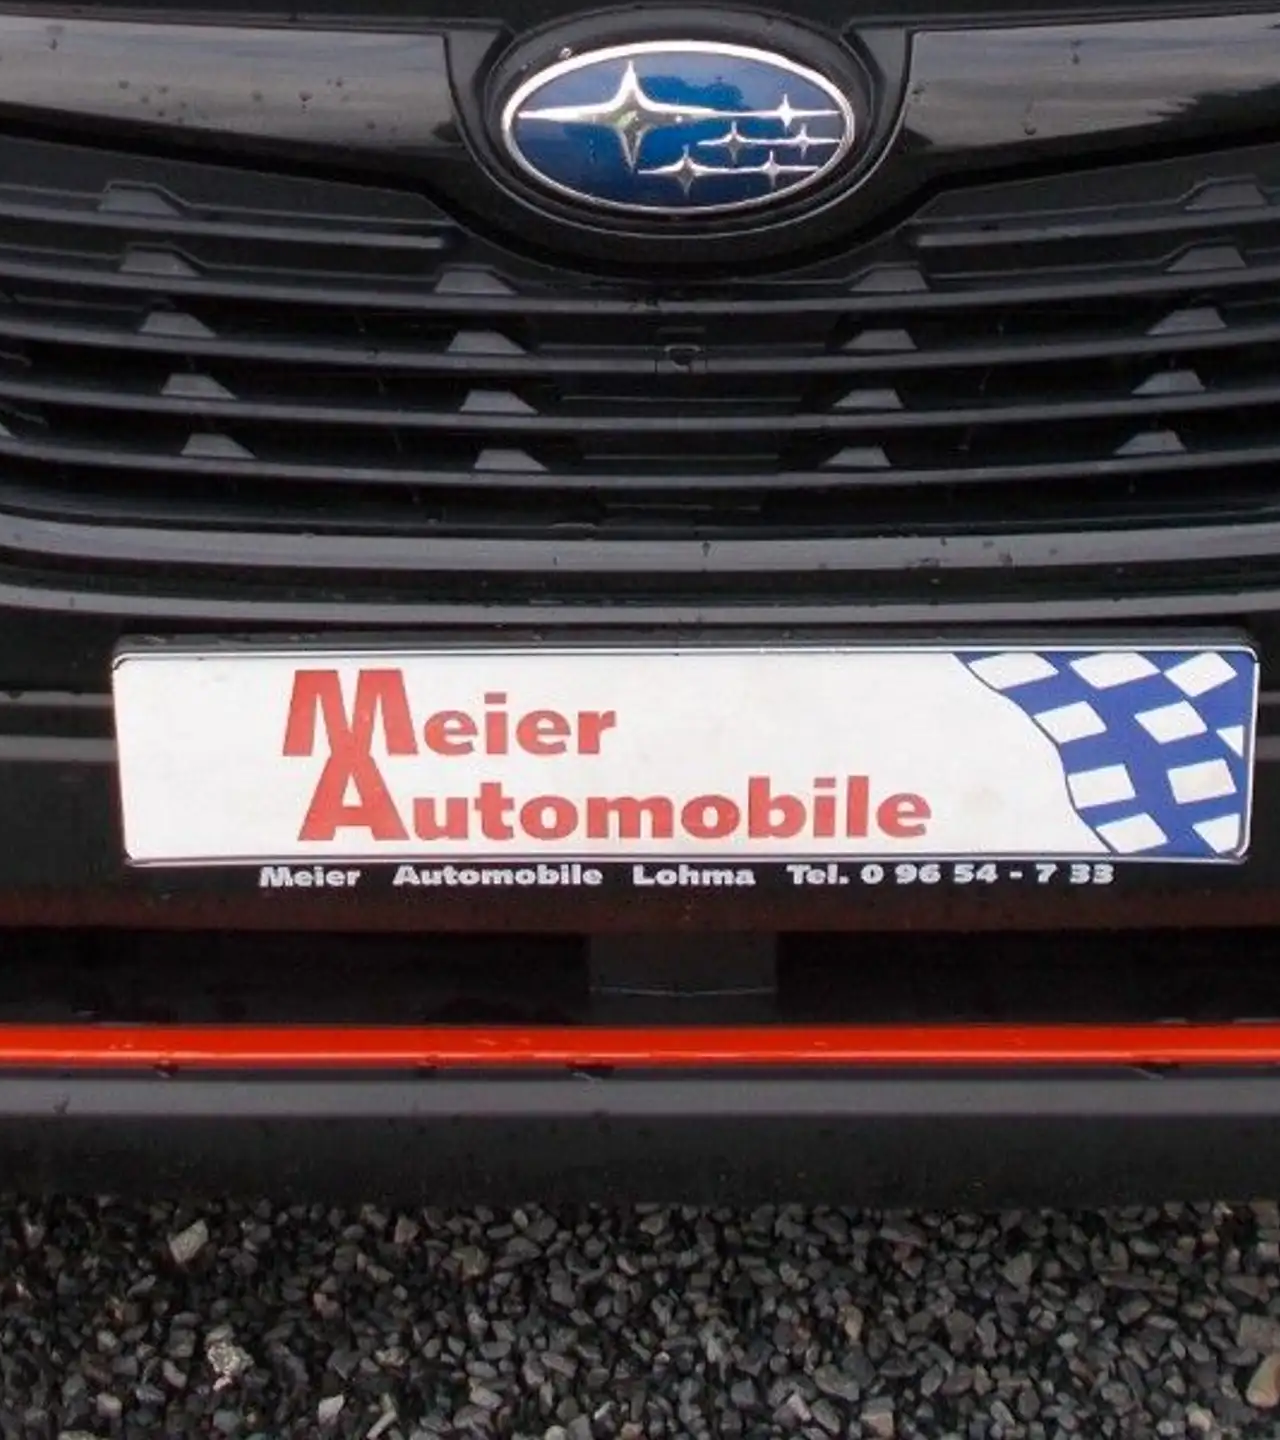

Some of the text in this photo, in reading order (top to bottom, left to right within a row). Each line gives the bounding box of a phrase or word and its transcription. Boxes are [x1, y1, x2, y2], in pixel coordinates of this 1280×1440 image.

[282, 669, 617, 757] Meier
[298, 752, 932, 841] Automobile
[260, 865, 362, 888] Meier
[392, 863, 603, 887] Automobile
[632, 863, 757, 887] Lohma
[786, 863, 850, 885] Tel.
[861, 863, 884, 885] 0
[894, 863, 942, 885] 96
[953, 863, 999, 885] 54
[1035, 863, 1057, 885] 7
[1070, 863, 1114, 885] 33
